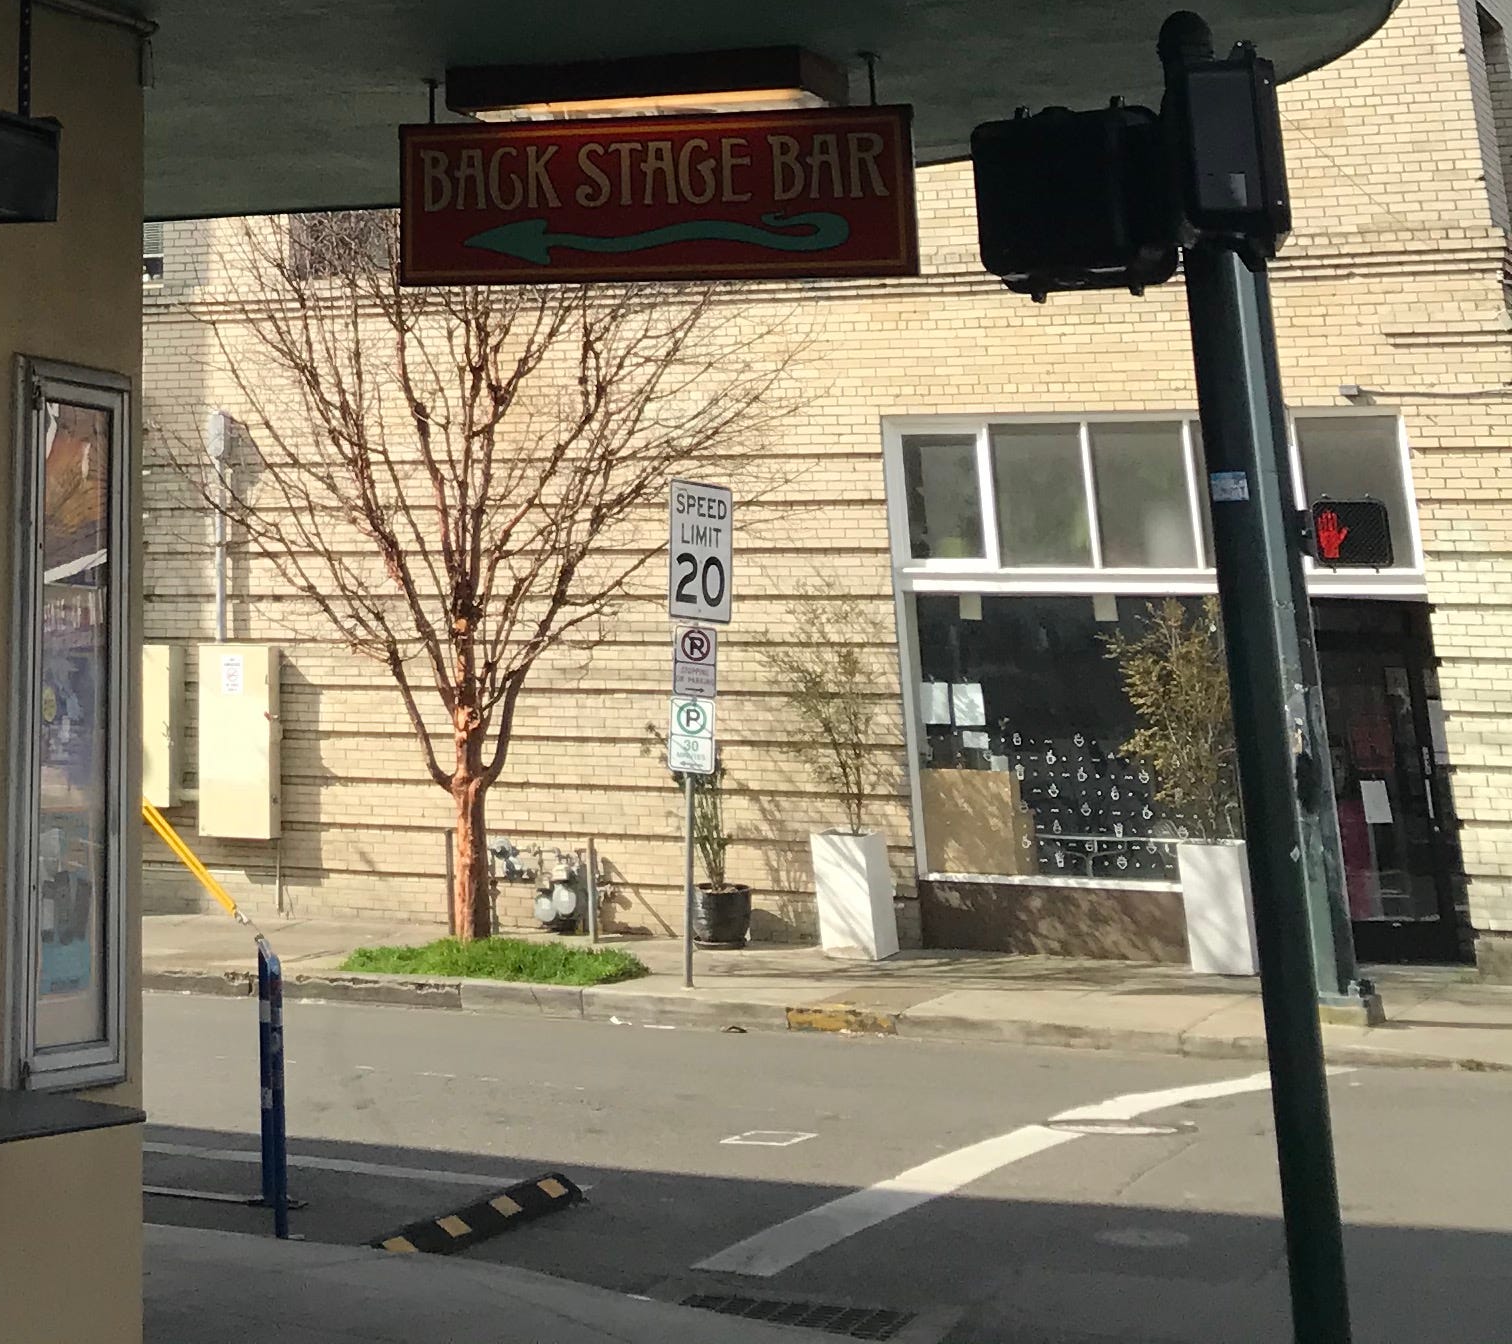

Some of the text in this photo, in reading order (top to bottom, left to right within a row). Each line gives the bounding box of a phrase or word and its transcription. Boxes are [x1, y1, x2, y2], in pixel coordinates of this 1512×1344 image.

[419, 131, 890, 212] BACK STAGE BAR
[676, 493, 728, 521] SPEED
[681, 522, 722, 549] LIMIT
[675, 552, 726, 608] 20
[684, 739, 699, 752] 30
